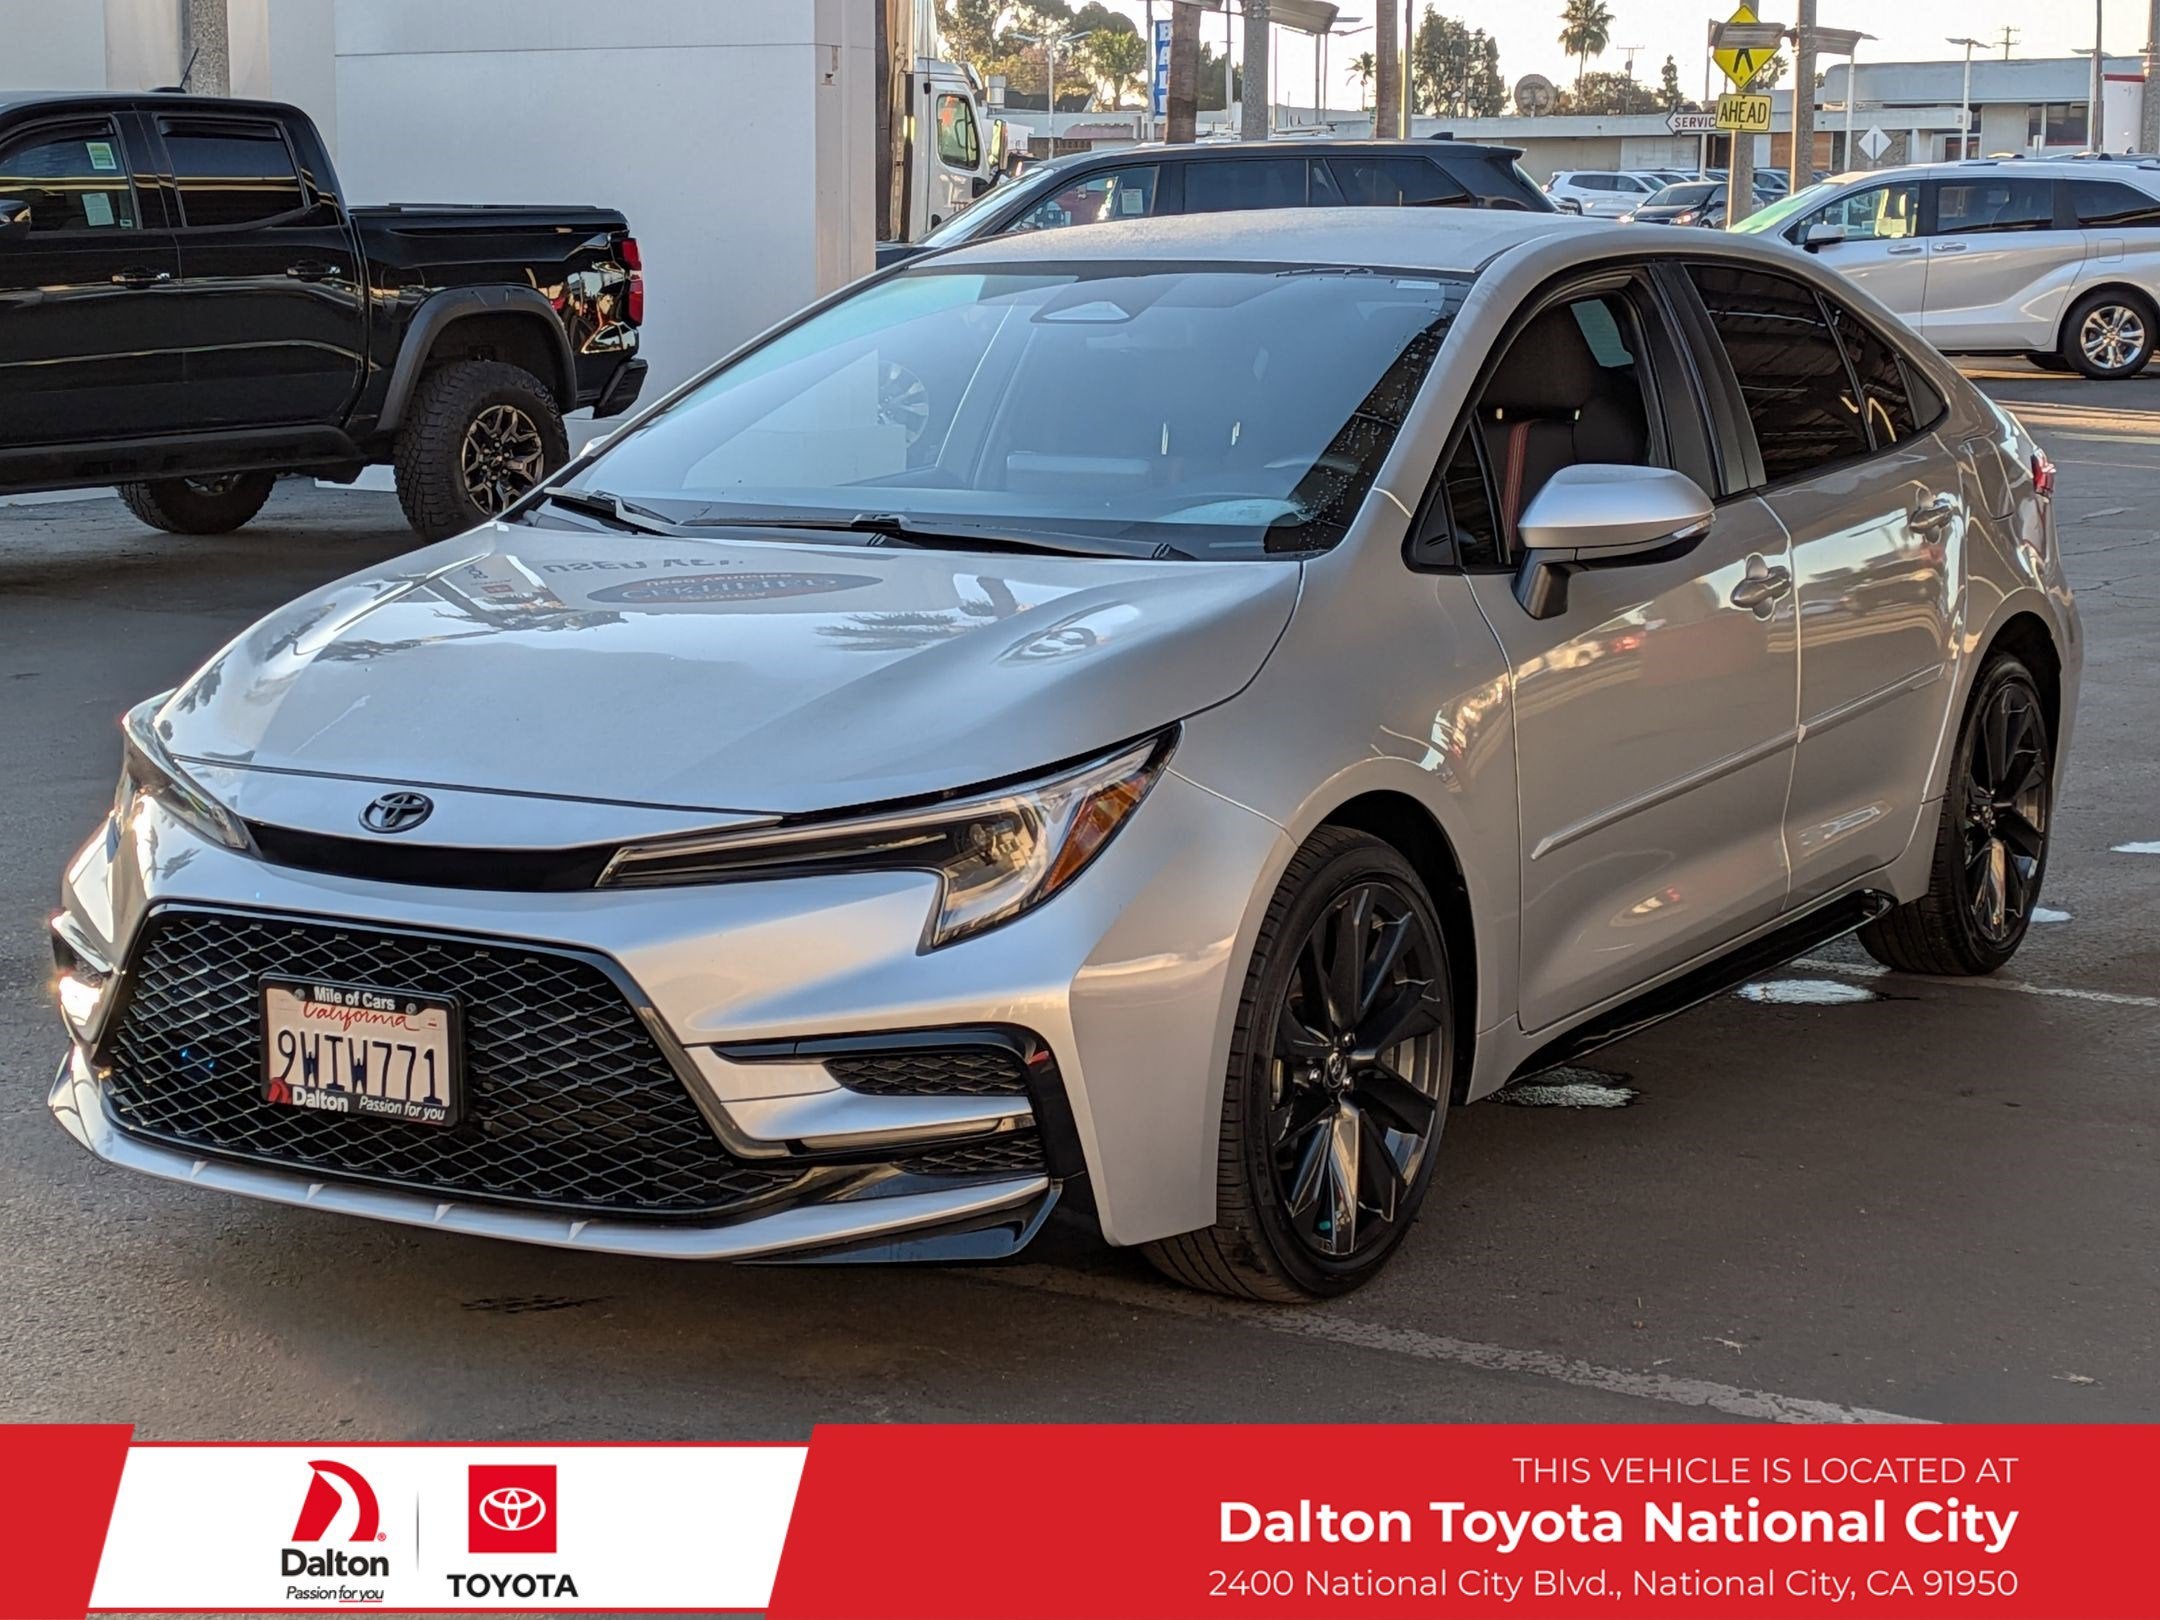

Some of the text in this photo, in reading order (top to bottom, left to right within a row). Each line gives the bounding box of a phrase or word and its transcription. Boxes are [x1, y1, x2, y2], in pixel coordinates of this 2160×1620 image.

[1674, 117, 1717, 128] SERVIC
[1720, 101, 1767, 124] AHEAD
[313, 986, 396, 1010] Mile of Cars
[303, 1001, 421, 1032] California
[277, 1029, 443, 1106] 9WIW771
[292, 1086, 445, 1121] Dalton Passion for you
